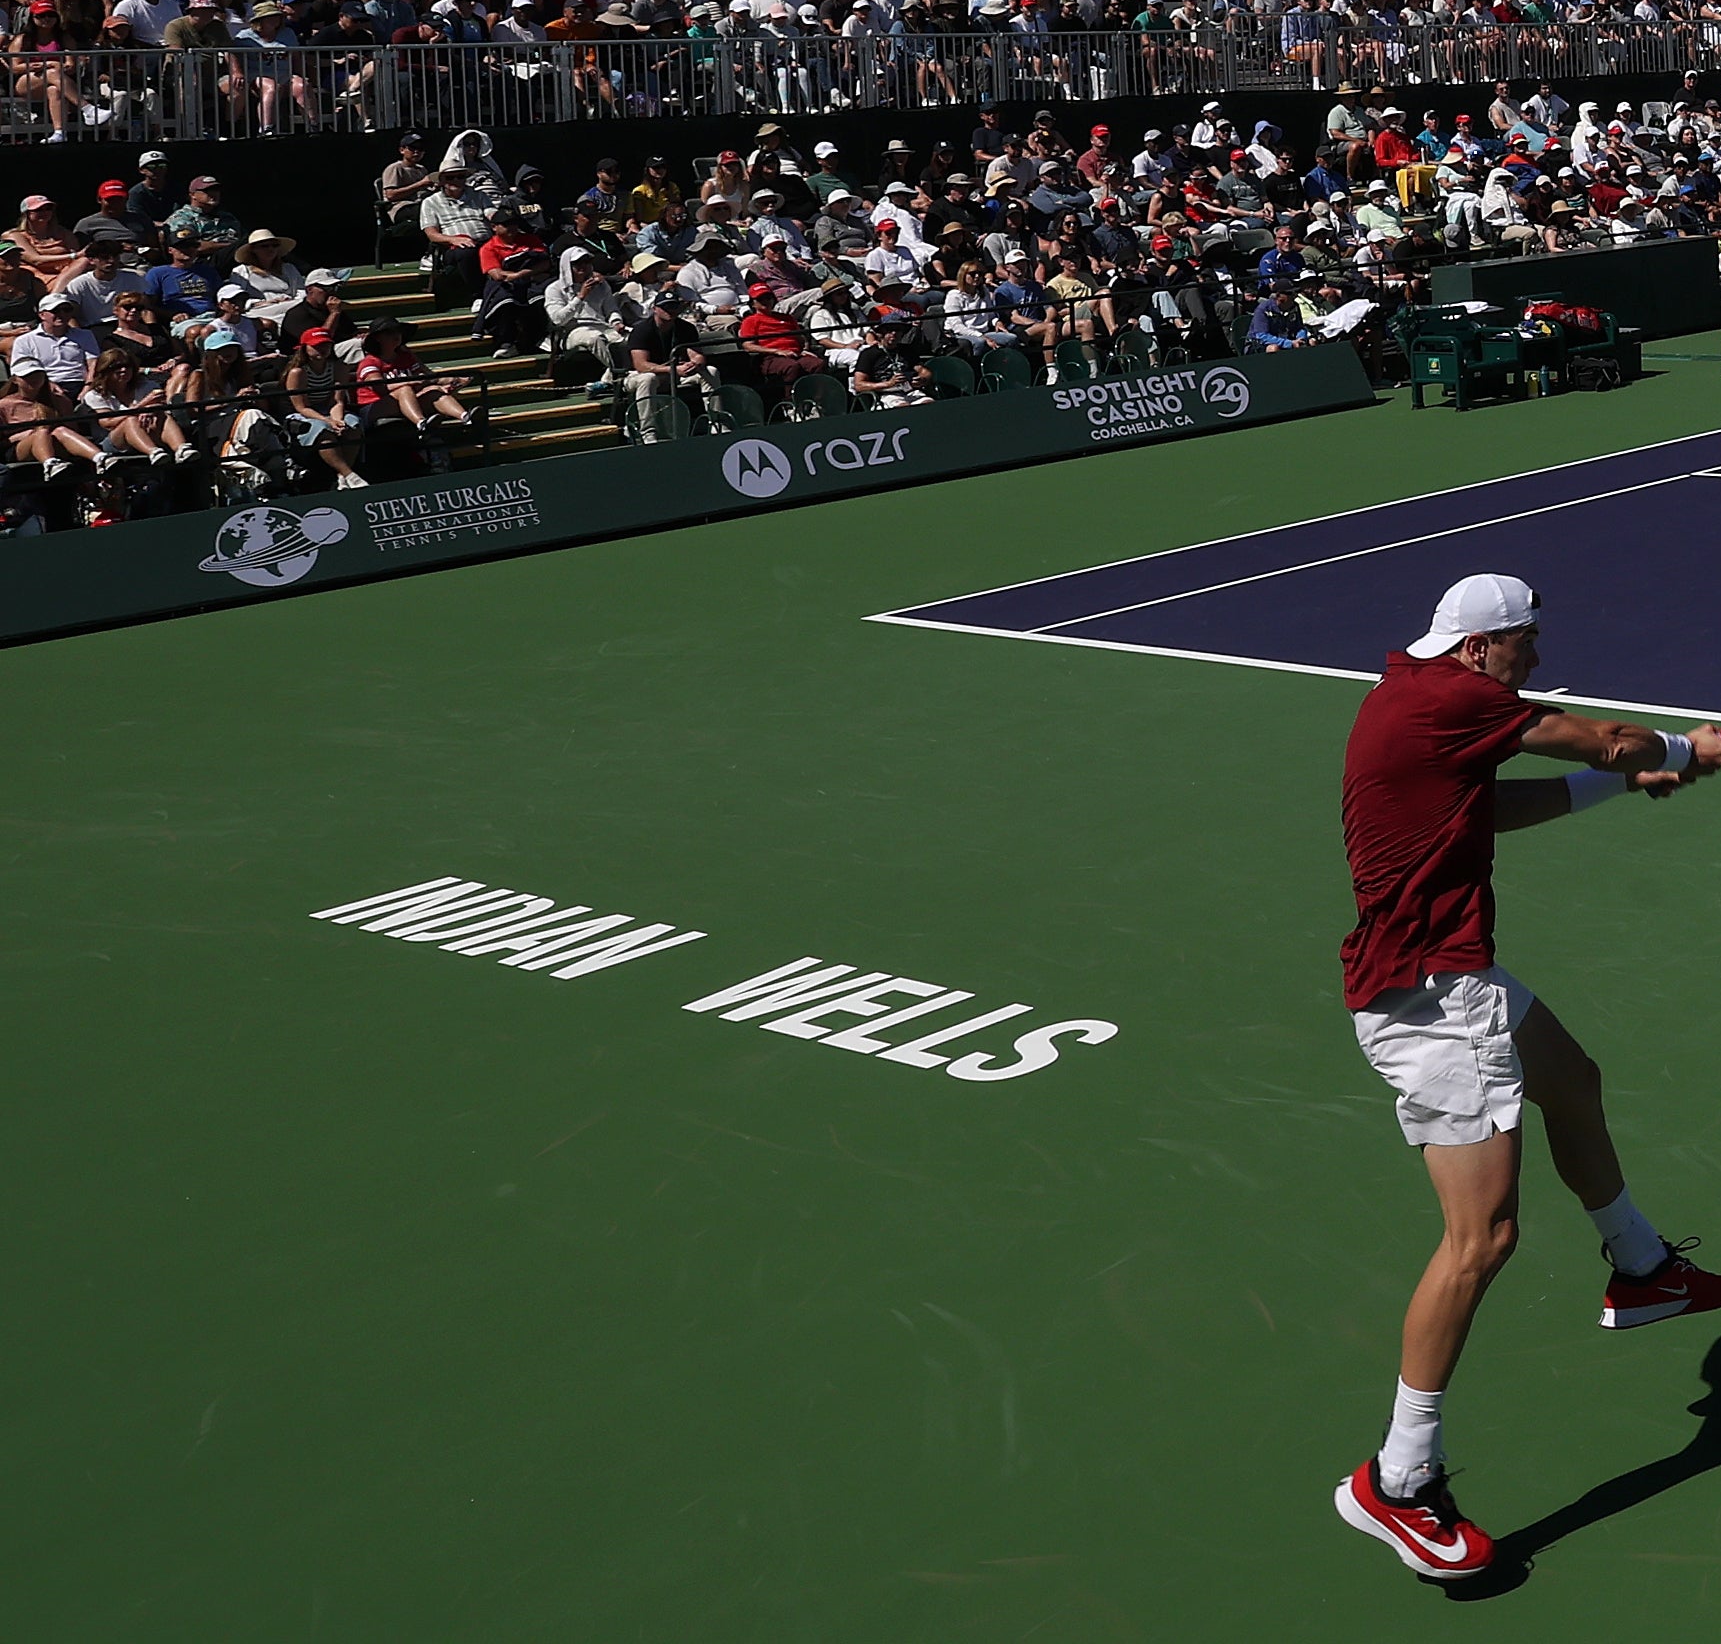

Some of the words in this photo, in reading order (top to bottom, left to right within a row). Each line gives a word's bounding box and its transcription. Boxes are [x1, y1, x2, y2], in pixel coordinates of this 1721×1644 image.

[1053, 370, 1197, 410] SPOTLIGHT
[1087, 395, 1183, 425] CASINO
[1175, 415, 1195, 427] CA
[804, 428, 910, 476] razr
[365, 495, 431, 523] STEVE
[435, 478, 532, 511] FURGAL'S
[372, 504, 538, 539] INTERNATIONAL
[377, 531, 457, 552] TENNIS
[474, 516, 541, 536] TOURS
[309, 876, 708, 980] INDIAN
[681, 956, 1119, 1081] WELLS
